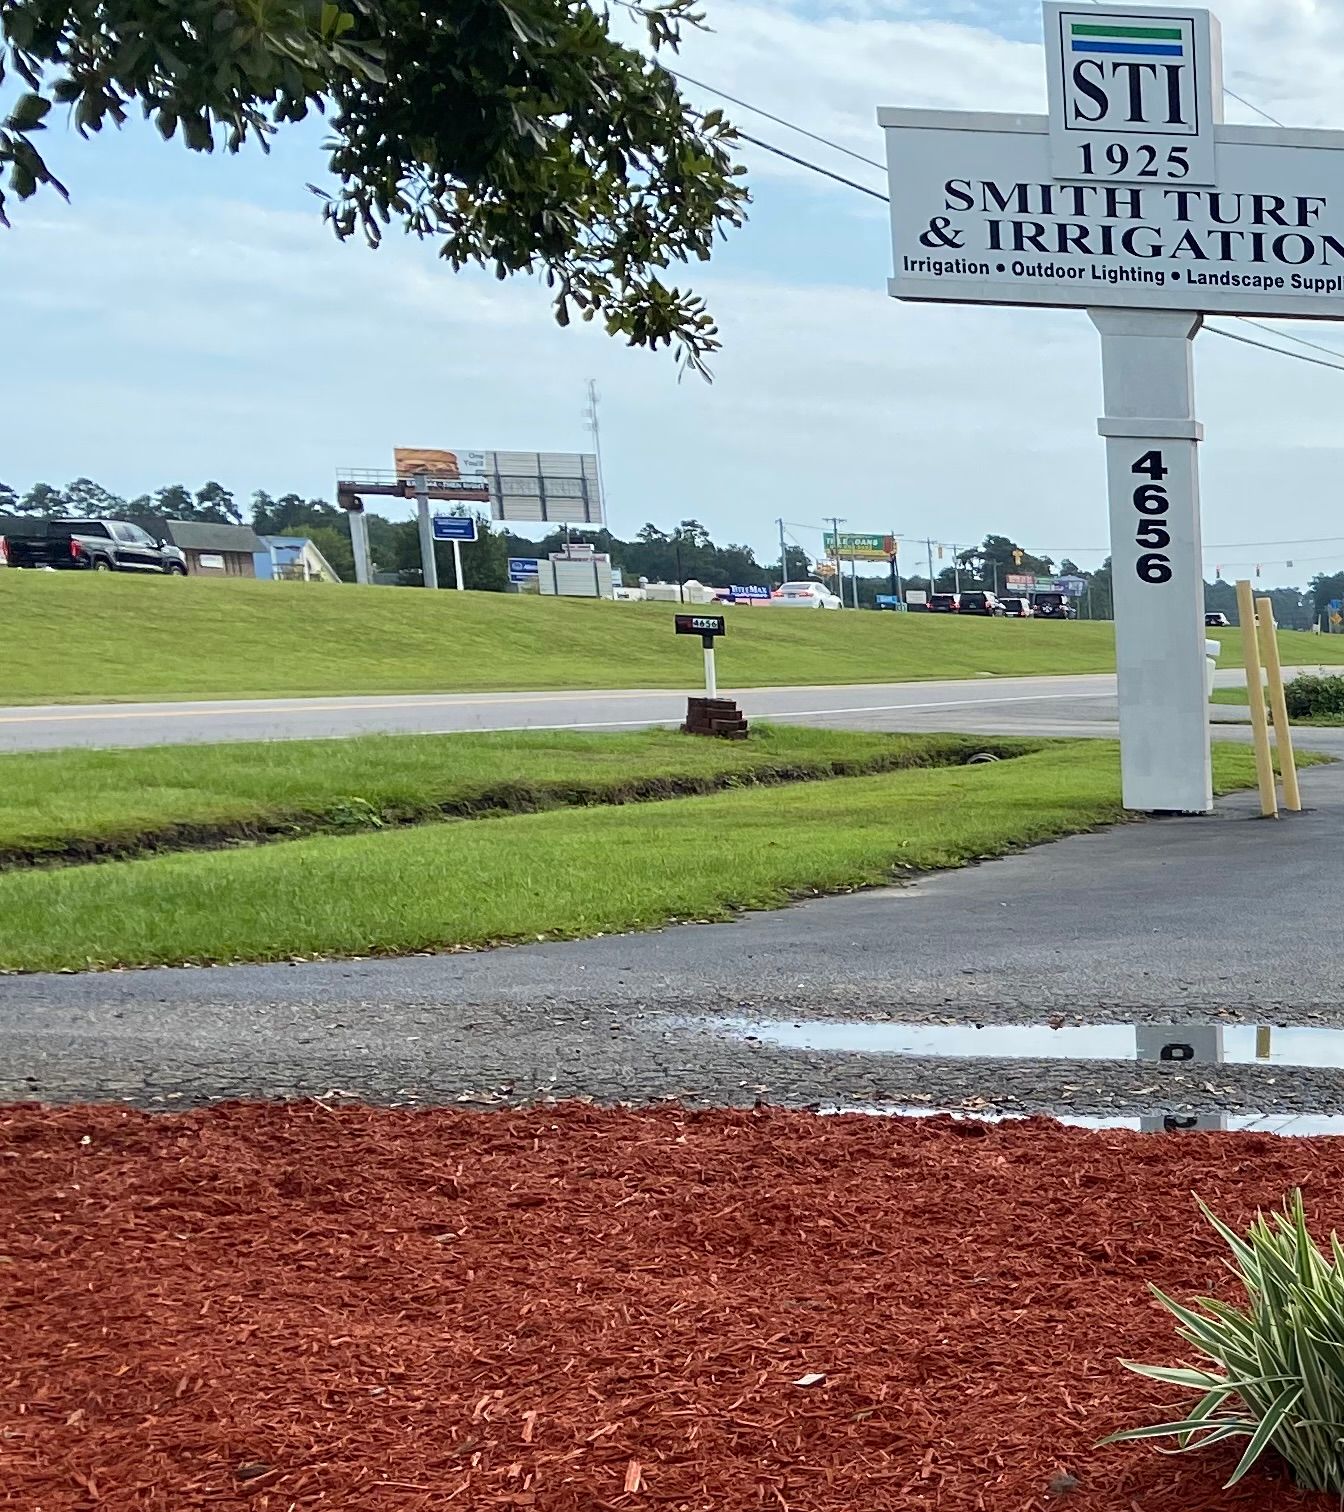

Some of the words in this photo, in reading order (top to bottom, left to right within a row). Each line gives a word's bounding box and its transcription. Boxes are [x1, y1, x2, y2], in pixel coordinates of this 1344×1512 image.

[1071, 59, 1188, 125] STI
[1077, 143, 1190, 179] 1925
[944, 179, 1148, 220] SMITH
[1163, 190, 1327, 229] TURF
[919, 216, 965, 249] &
[902, 256, 990, 276] Irrigation
[1011, 261, 1086, 281] Outdoor
[1091, 264, 1165, 286] Lighting
[1187, 269, 1285, 291] Landscape
[1131, 450, 1172, 584] 4656
[826, 537, 848, 545] TILE
[693, 619, 718, 628] 4656
